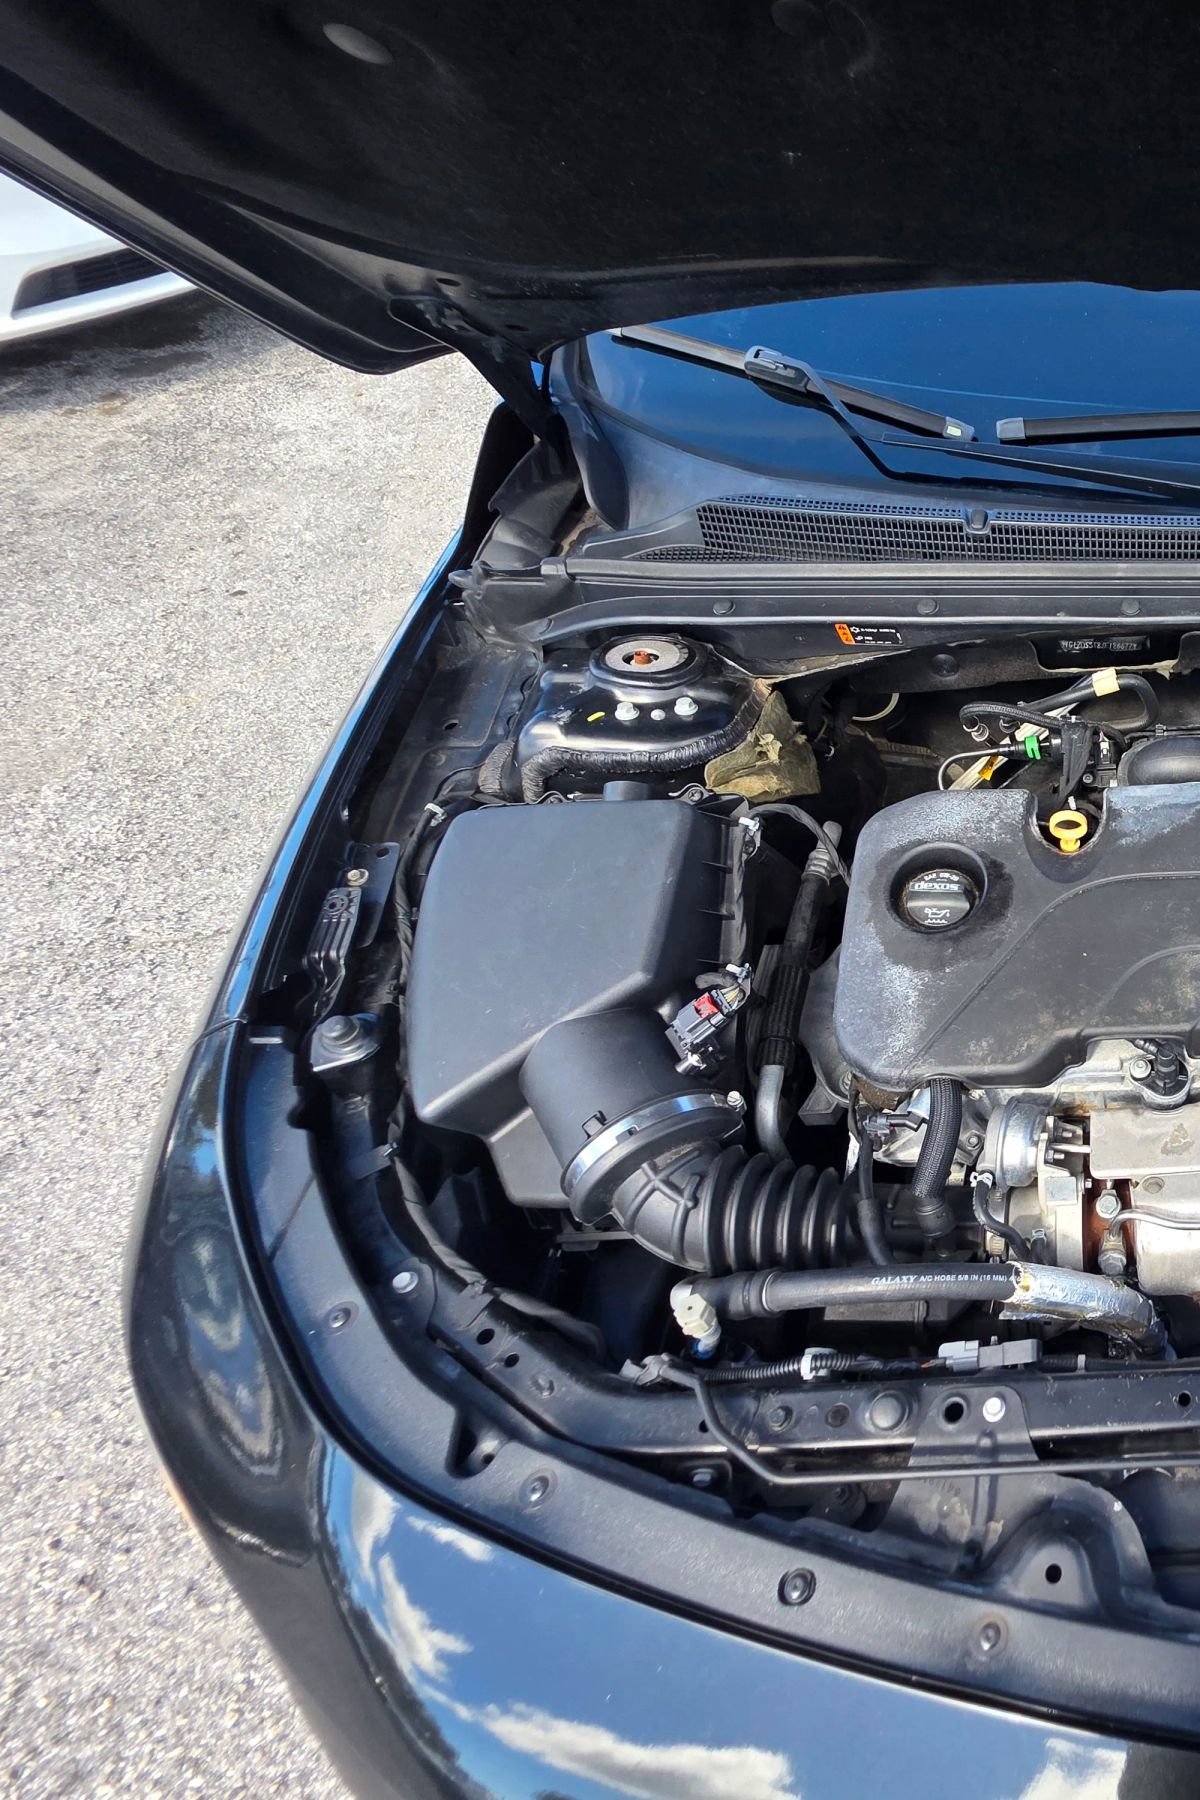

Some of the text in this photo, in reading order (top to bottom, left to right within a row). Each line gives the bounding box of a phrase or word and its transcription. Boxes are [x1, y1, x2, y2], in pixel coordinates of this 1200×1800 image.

[915, 881, 960, 890] dexos
[871, 1275, 918, 1285] GALAXY
[992, 1275, 1008, 1283] MM)
